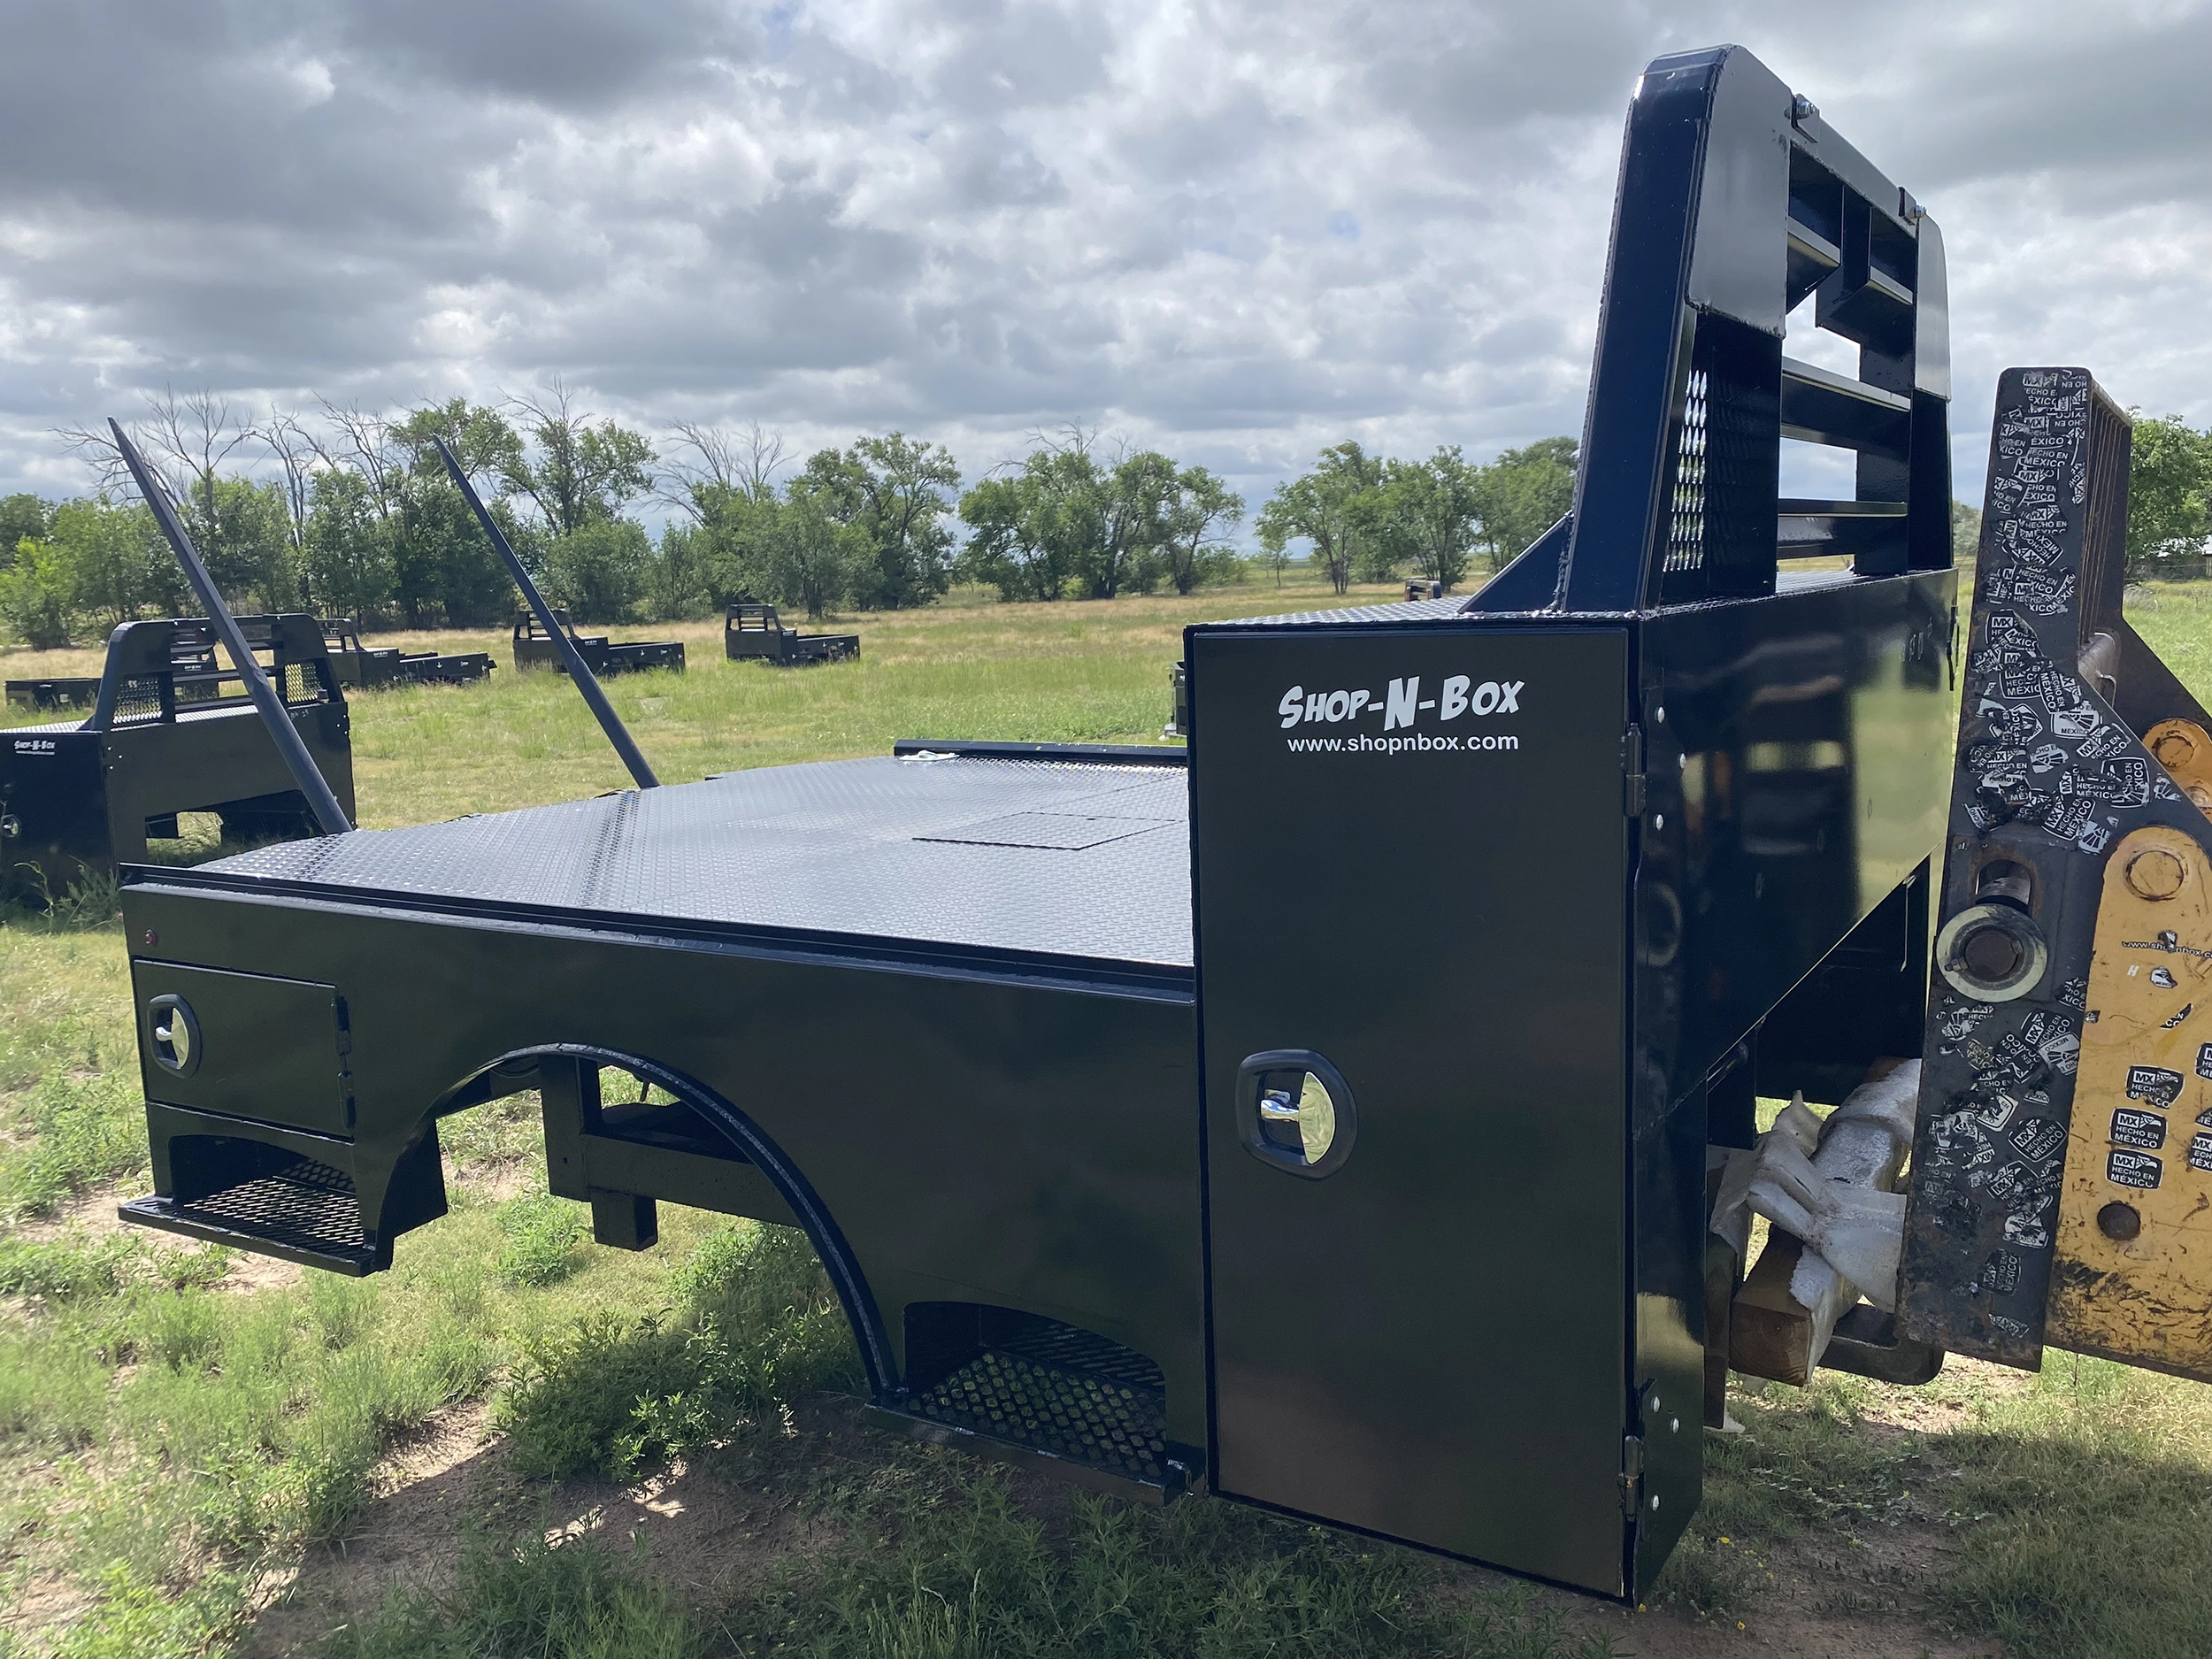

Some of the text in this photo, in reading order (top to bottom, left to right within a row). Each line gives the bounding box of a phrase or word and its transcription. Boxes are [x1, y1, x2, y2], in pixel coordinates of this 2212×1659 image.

[2031, 436, 2064, 446] ÉXICO
[2000, 445, 2023, 456] XICO
[2019, 471, 2039, 483] MX
[1993, 500, 2011, 511] ICO
[2018, 569, 2046, 582] HECHO
[2046, 577, 2059, 587] EN
[1993, 618, 2013, 627] MX
[1287, 733, 1519, 756] www.shopnbox.com
[2091, 743, 2111, 759] ECHO
[2133, 762, 2144, 788] XICO
[2044, 808, 2063, 828] MX
[2062, 994, 2085, 1009] XICO
[2025, 1024, 2043, 1044] MX
[2134, 1072, 2154, 1085] MX
[2118, 1115, 2139, 1128] MX
[2016, 1131, 2035, 1147] MX
[2024, 1124, 2057, 1153] HECHO EN
[2115, 1133, 2158, 1148] MÉXICO
[2116, 1125, 2159, 1141] HECHO EN
[2115, 1156, 2135, 1168] MX
[2194, 1150, 2212, 1160] ECH
[2111, 1166, 2141, 1178] HECHO
[1992, 1179, 2012, 1195] MX
